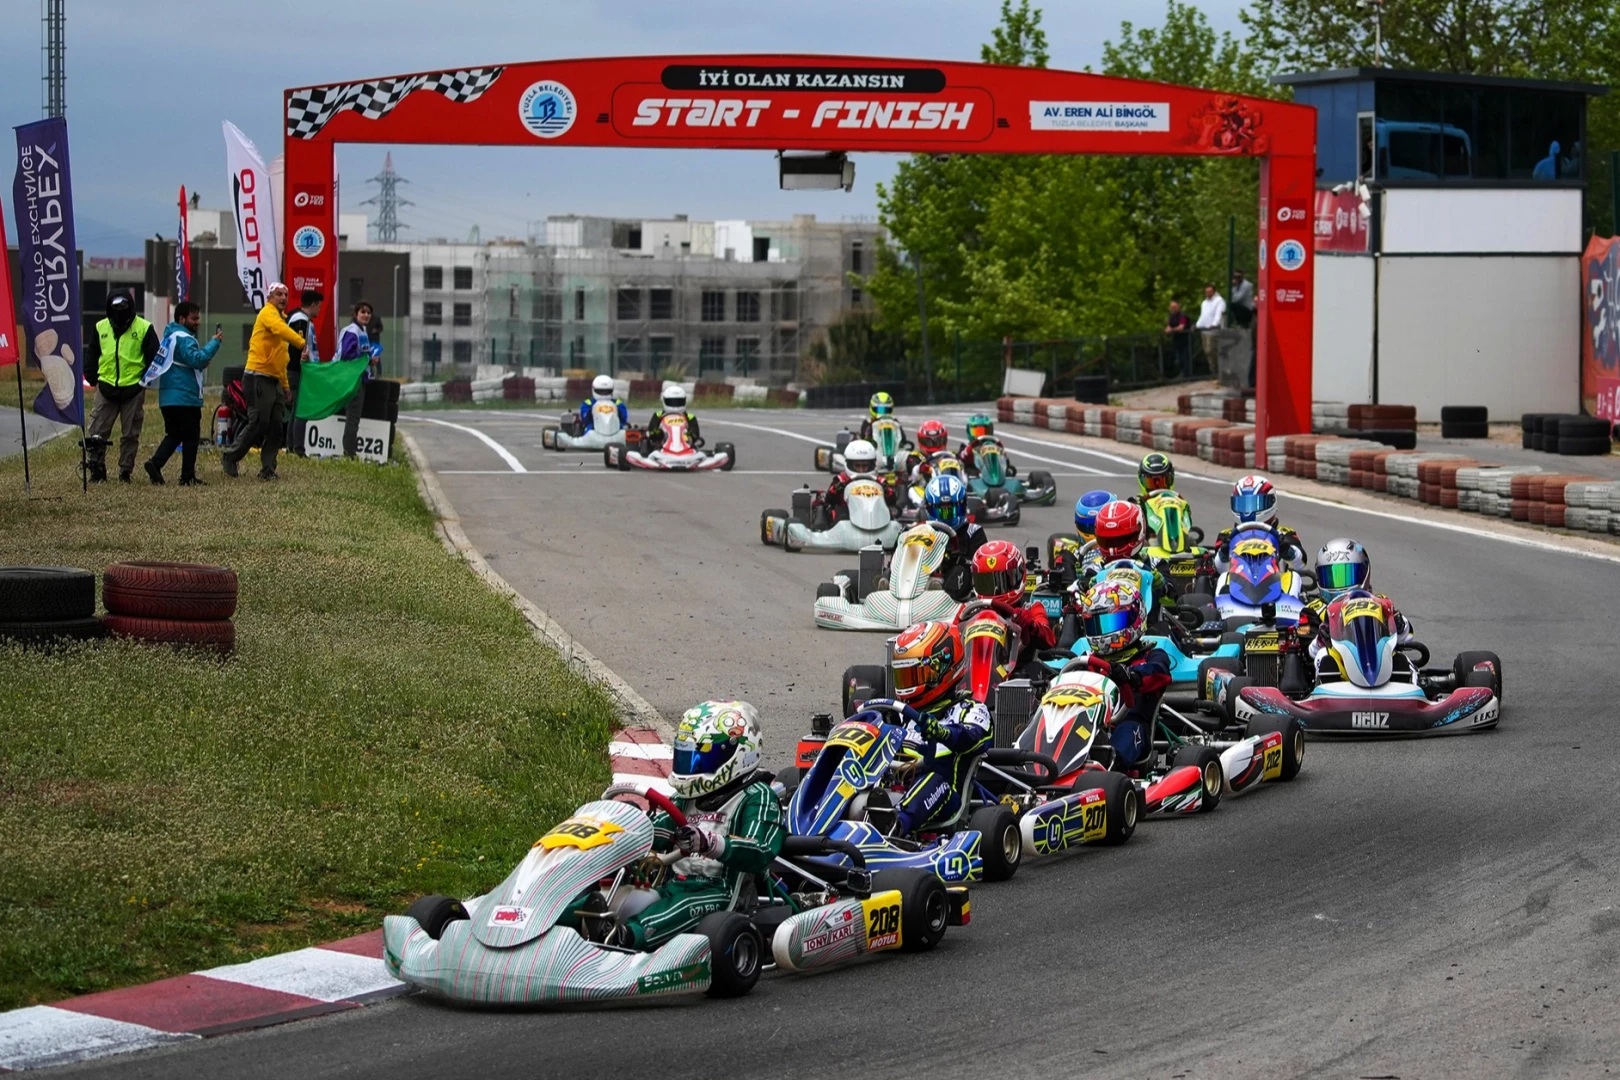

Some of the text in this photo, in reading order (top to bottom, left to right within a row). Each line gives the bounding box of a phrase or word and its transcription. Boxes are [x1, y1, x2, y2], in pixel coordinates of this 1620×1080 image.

[699, 69, 906, 89] İYİ OLAN KAZANSIN
[523, 89, 538, 114] TUZLA
[1043, 104, 1157, 118] AV. EREN ALİ BİNGÖL
[632, 98, 772, 127] START
[811, 100, 975, 130] FINISH
[1114, 121, 1149, 129] BAŞKANI
[356, 435, 384, 456] eza
[1240, 543, 1269, 552] 210
[1344, 601, 1380, 616] 297
[1046, 688, 1093, 701] 202
[1265, 750, 1281, 772] 202
[868, 904, 900, 939] 208
[803, 924, 853, 953] TONY KART
[869, 934, 897, 950] MOTUL
